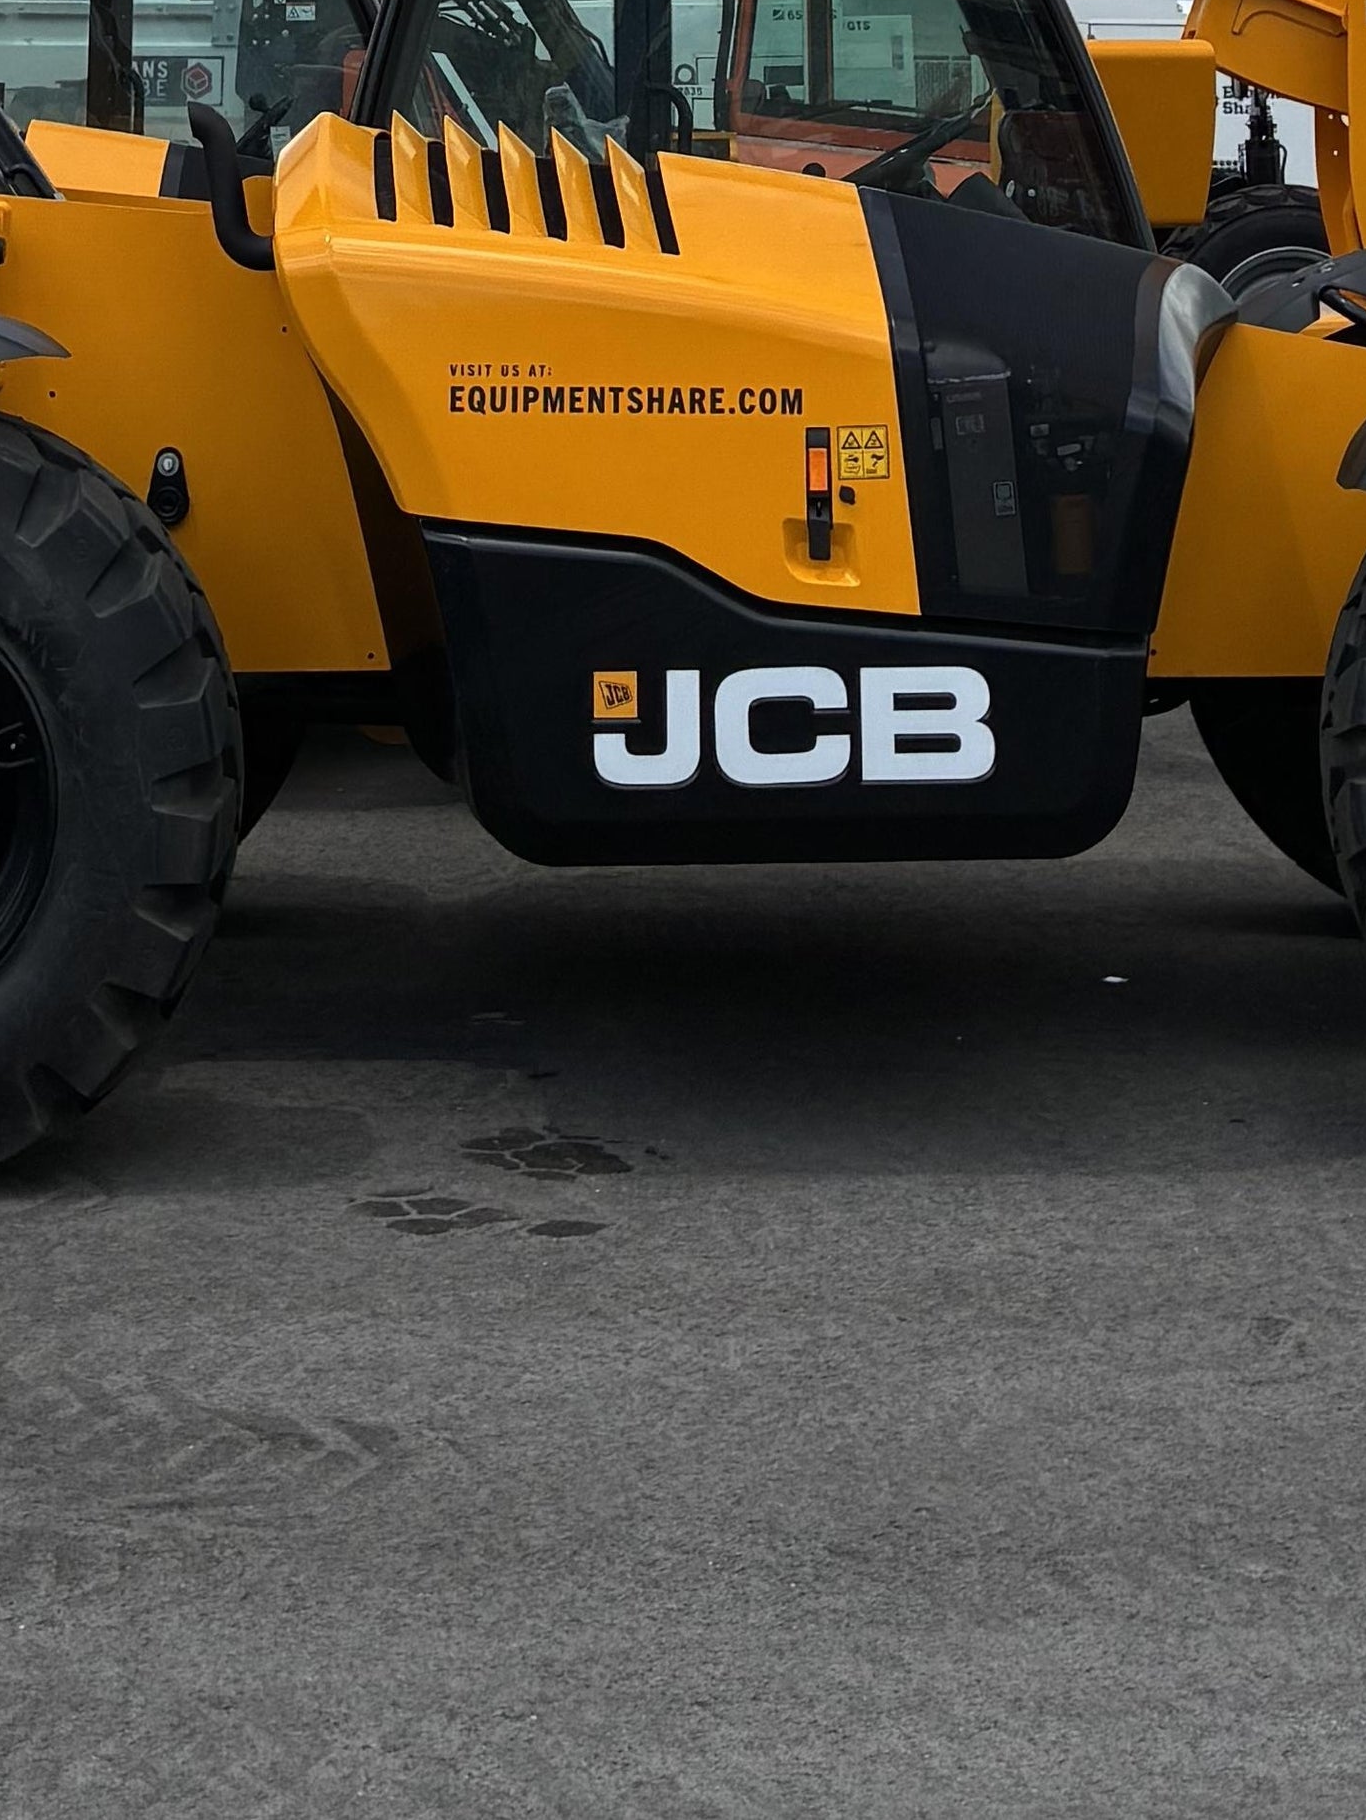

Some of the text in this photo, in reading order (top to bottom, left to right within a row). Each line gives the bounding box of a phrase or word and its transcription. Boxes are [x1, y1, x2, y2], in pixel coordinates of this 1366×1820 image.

[449, 364, 553, 377] VISIT US AT:
[449, 385, 804, 416] EQUIPMENTSHARE.COM
[600, 681, 633, 709] JCB
[593, 666, 996, 786] JCB
